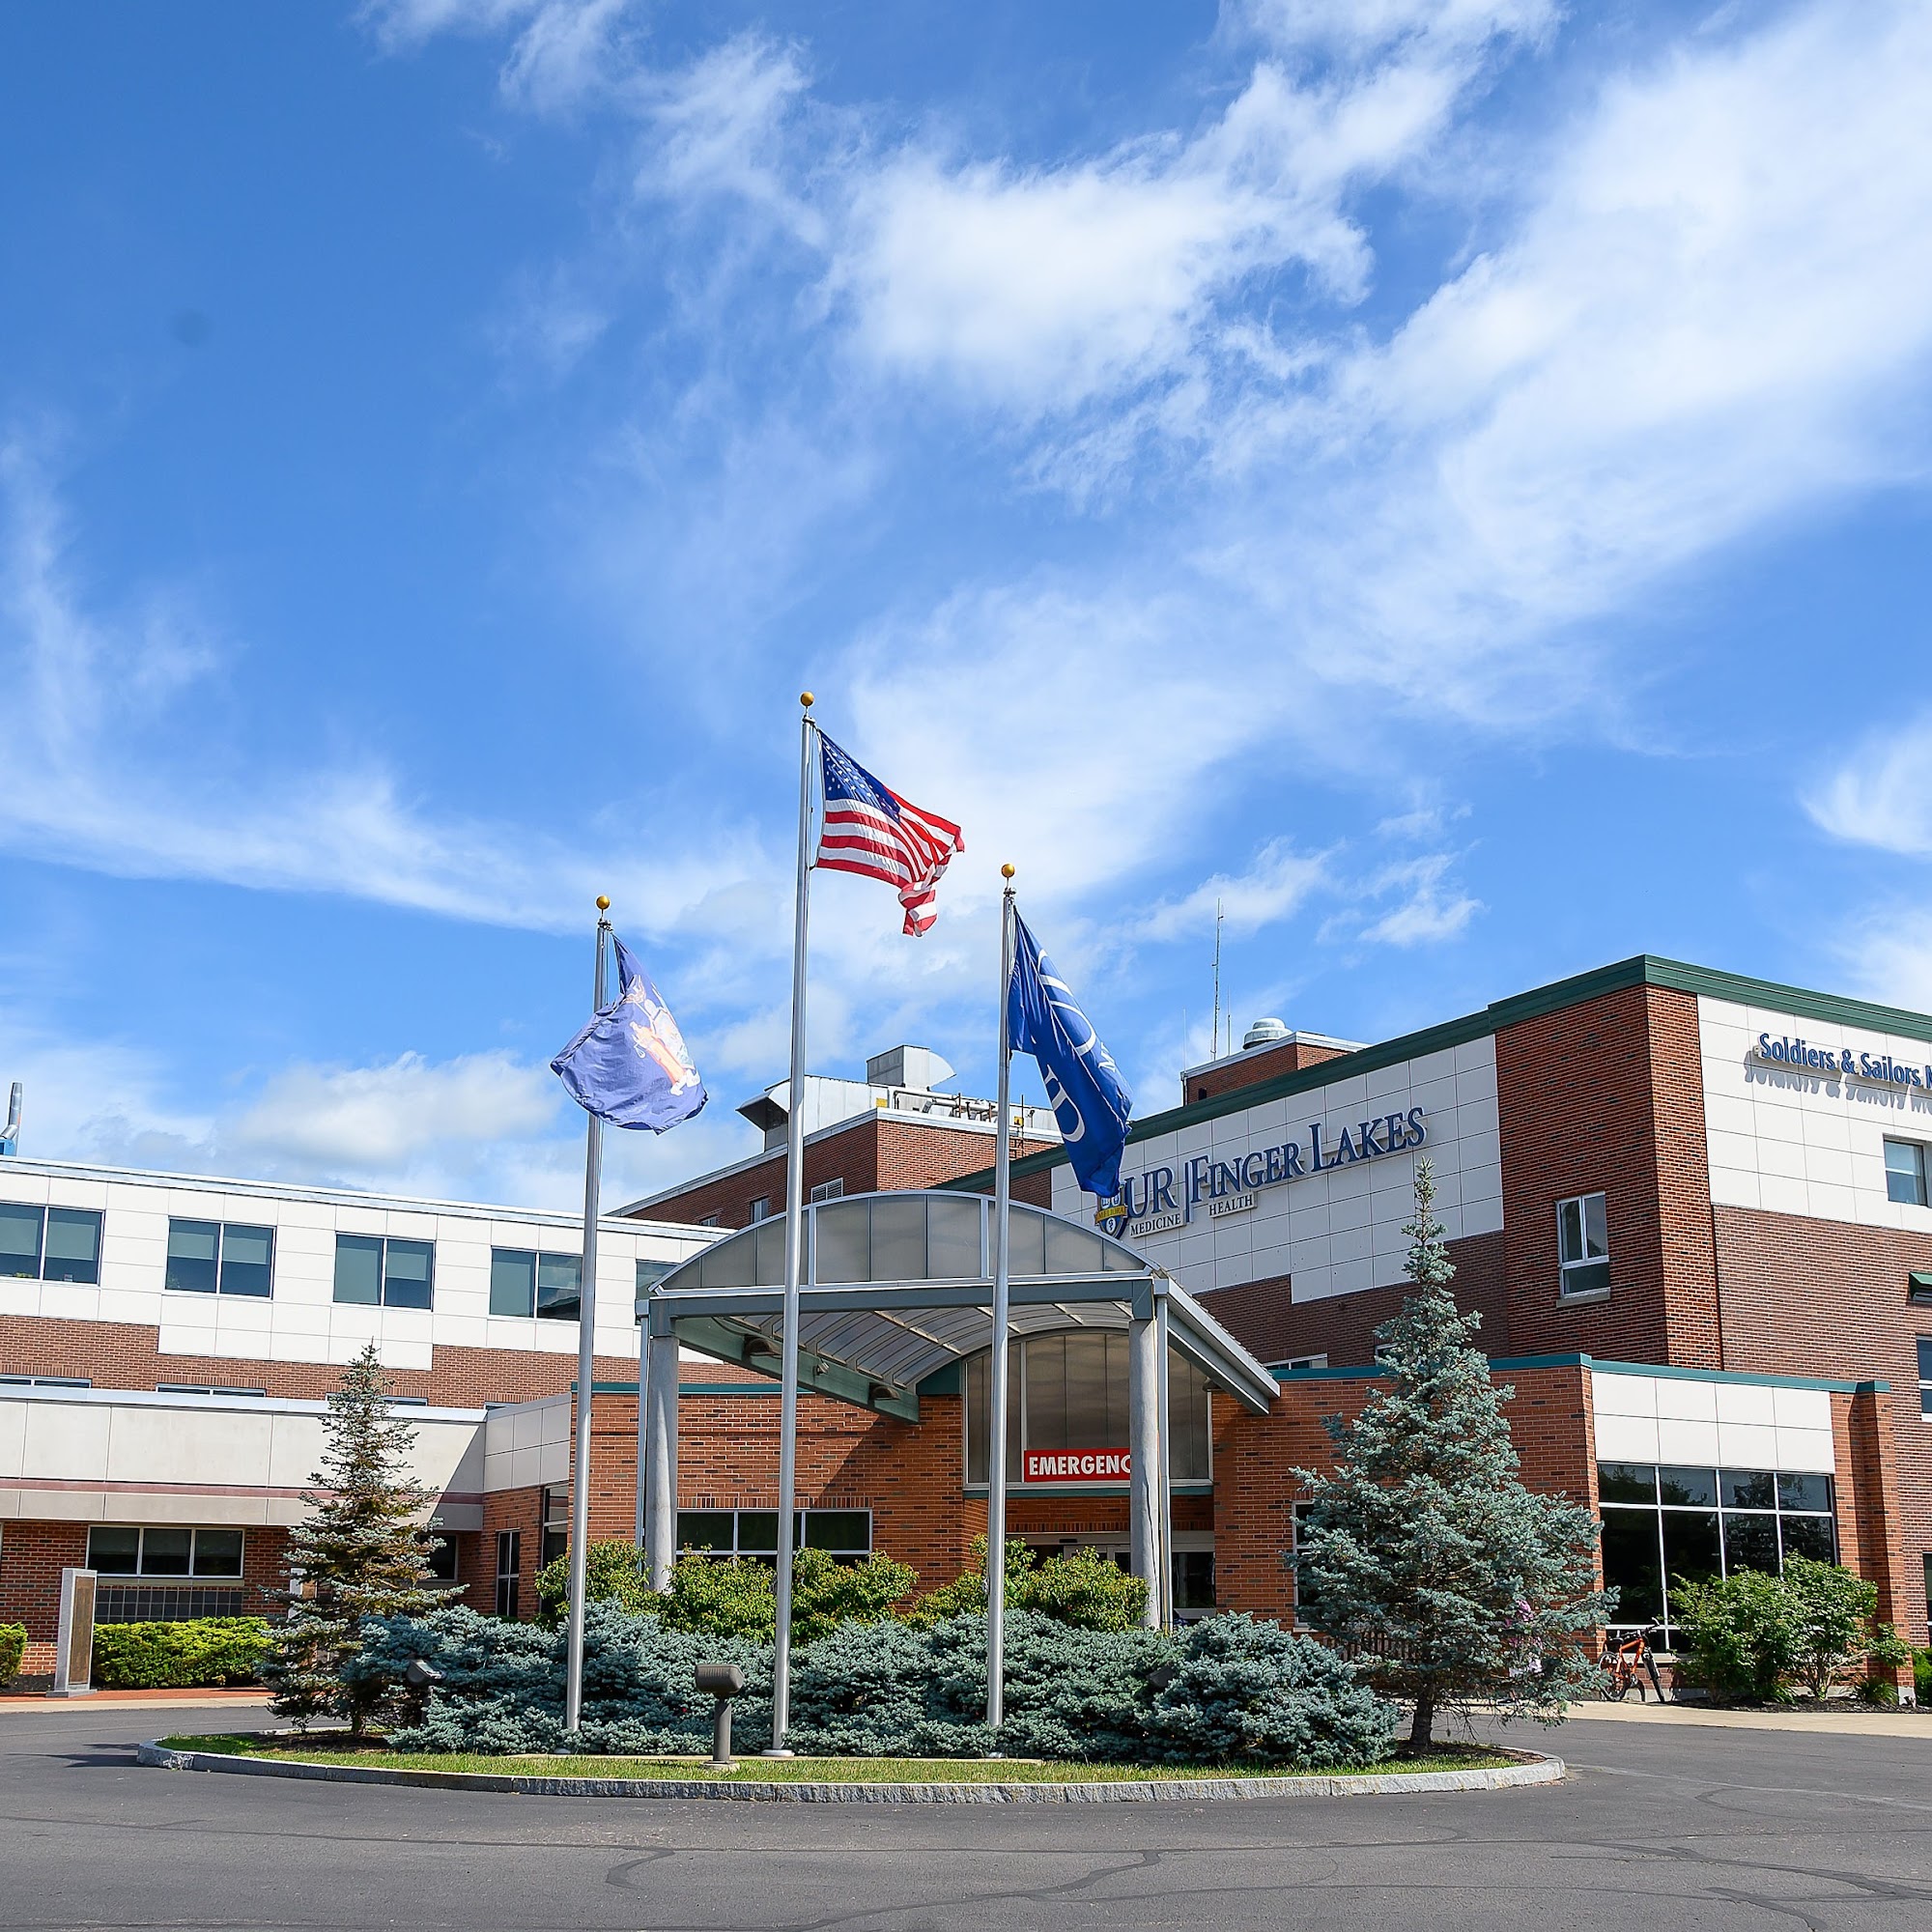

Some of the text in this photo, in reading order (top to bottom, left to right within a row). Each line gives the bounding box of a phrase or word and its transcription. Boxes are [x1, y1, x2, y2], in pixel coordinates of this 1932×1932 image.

[1760, 1033, 1834, 1070] Soldiers
[1840, 1049, 1857, 1074] &
[1860, 1053, 1921, 1087] Sailors
[1124, 1107, 1427, 1219] UR FINGER LAKES
[1208, 1194, 1253, 1216] HEALTH
[1130, 1213, 1180, 1236] MEDICINE
[1029, 1455, 1131, 1476] EMERGENC
